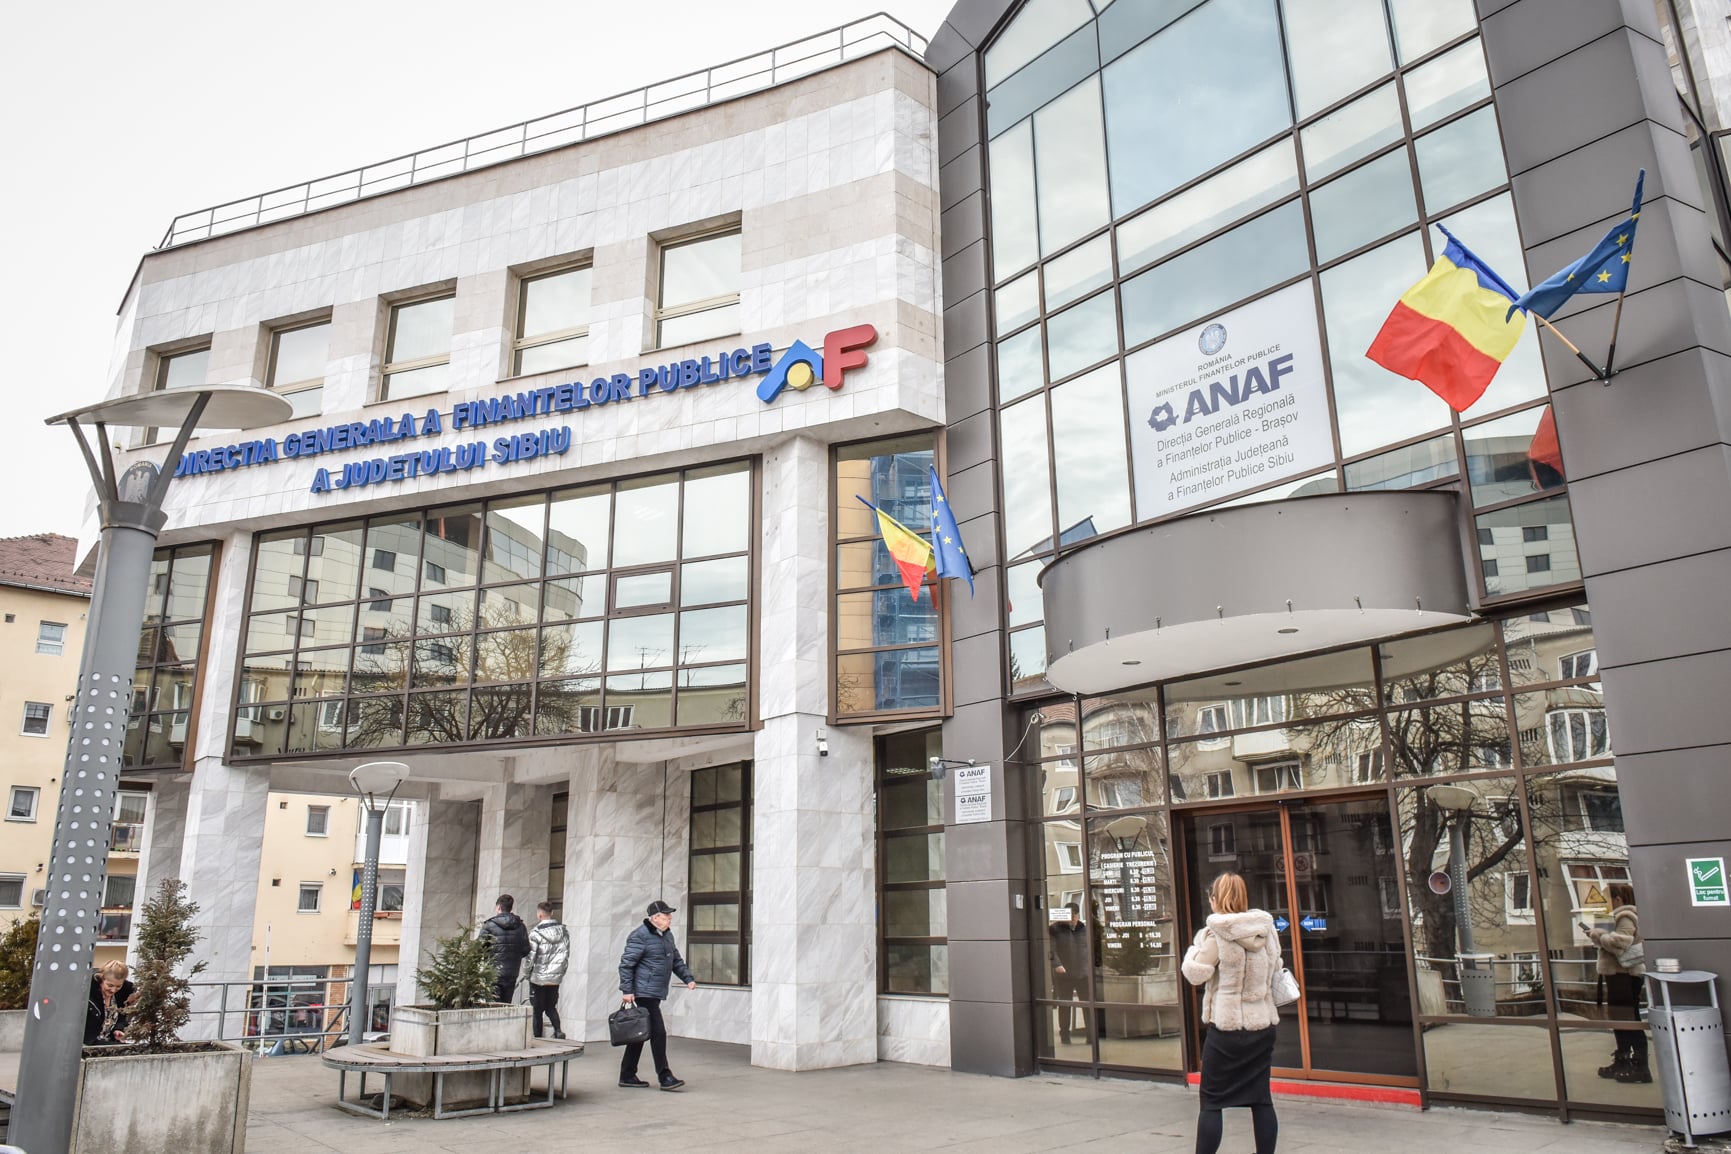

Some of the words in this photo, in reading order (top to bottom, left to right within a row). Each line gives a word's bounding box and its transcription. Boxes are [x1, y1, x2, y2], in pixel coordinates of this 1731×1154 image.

[1155, 377, 1198, 398] MINISTERUL
[1247, 344, 1281, 363] PUBLICE
[1182, 352, 1294, 425] ANAF
[173, 438, 278, 478] DIRECTIA
[283, 413, 416, 458] GENERALA
[421, 408, 443, 436] A
[452, 373, 631, 430] FINANTELOR
[639, 342, 773, 397] PUBLICE
[1195, 415, 1240, 439] Generală
[1242, 393, 1296, 422] Regională
[310, 467, 331, 494] A
[335, 441, 486, 490] JUDETULUI
[491, 425, 571, 465] SIBIU
[1156, 458, 1164, 468] a
[1215, 426, 1252, 448] Publice
[1167, 491, 1174, 501] a
[1227, 460, 1265, 481] Publice
[1267, 452, 1295, 470] Sibiu
